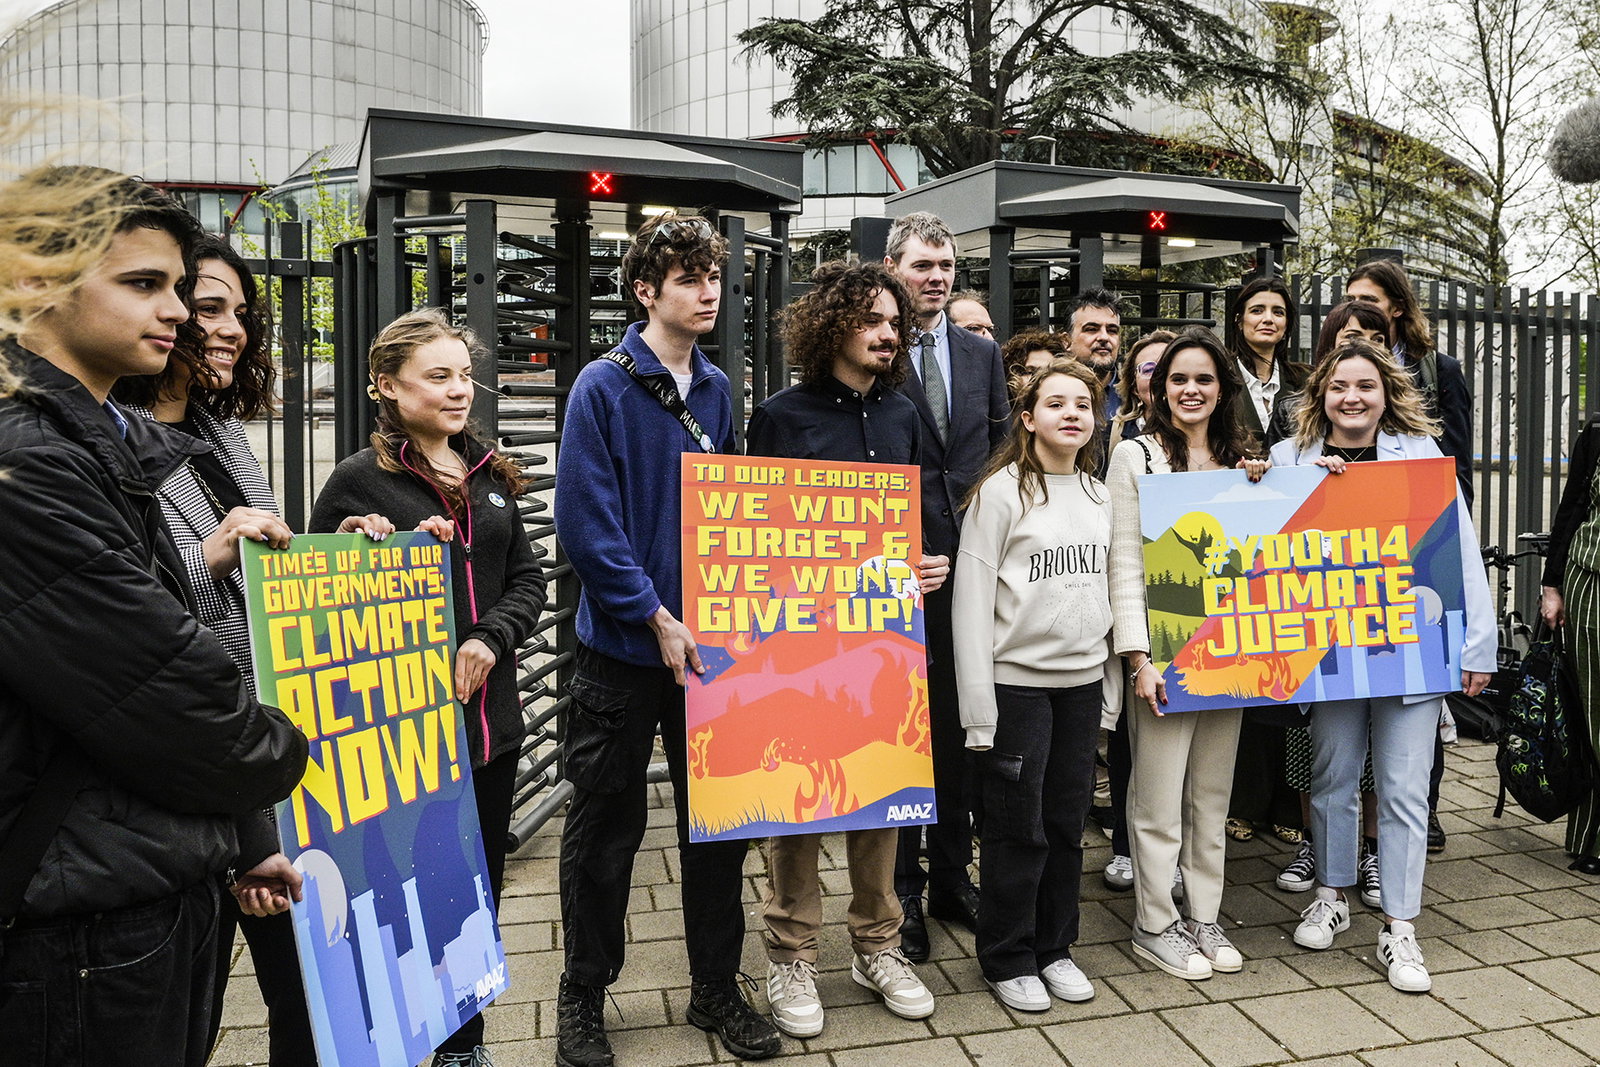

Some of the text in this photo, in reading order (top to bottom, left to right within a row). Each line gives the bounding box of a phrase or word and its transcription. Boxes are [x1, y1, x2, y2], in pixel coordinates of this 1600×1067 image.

[693, 464, 911, 492] TO OUR LEADERS:
[698, 489, 910, 524] WE WON'T
[259, 545, 443, 578] TIME'S UP FOR OUR
[697, 525, 911, 561] FORGET &
[1203, 525, 1411, 576] #YOUTH4
[262, 567, 446, 614] GOVERNMENTS:
[698, 558, 912, 594] WE WON'T
[1202, 565, 1419, 618] CLIMATE
[268, 597, 448, 672] CLIMATE
[697, 596, 915, 633] GIVE UP!
[1207, 604, 1420, 658] JUSTICE
[276, 645, 453, 740] ACTION
[291, 703, 461, 848] NOW!
[886, 803, 933, 822] AVAAZ
[475, 962, 505, 1003] AVAAZ
